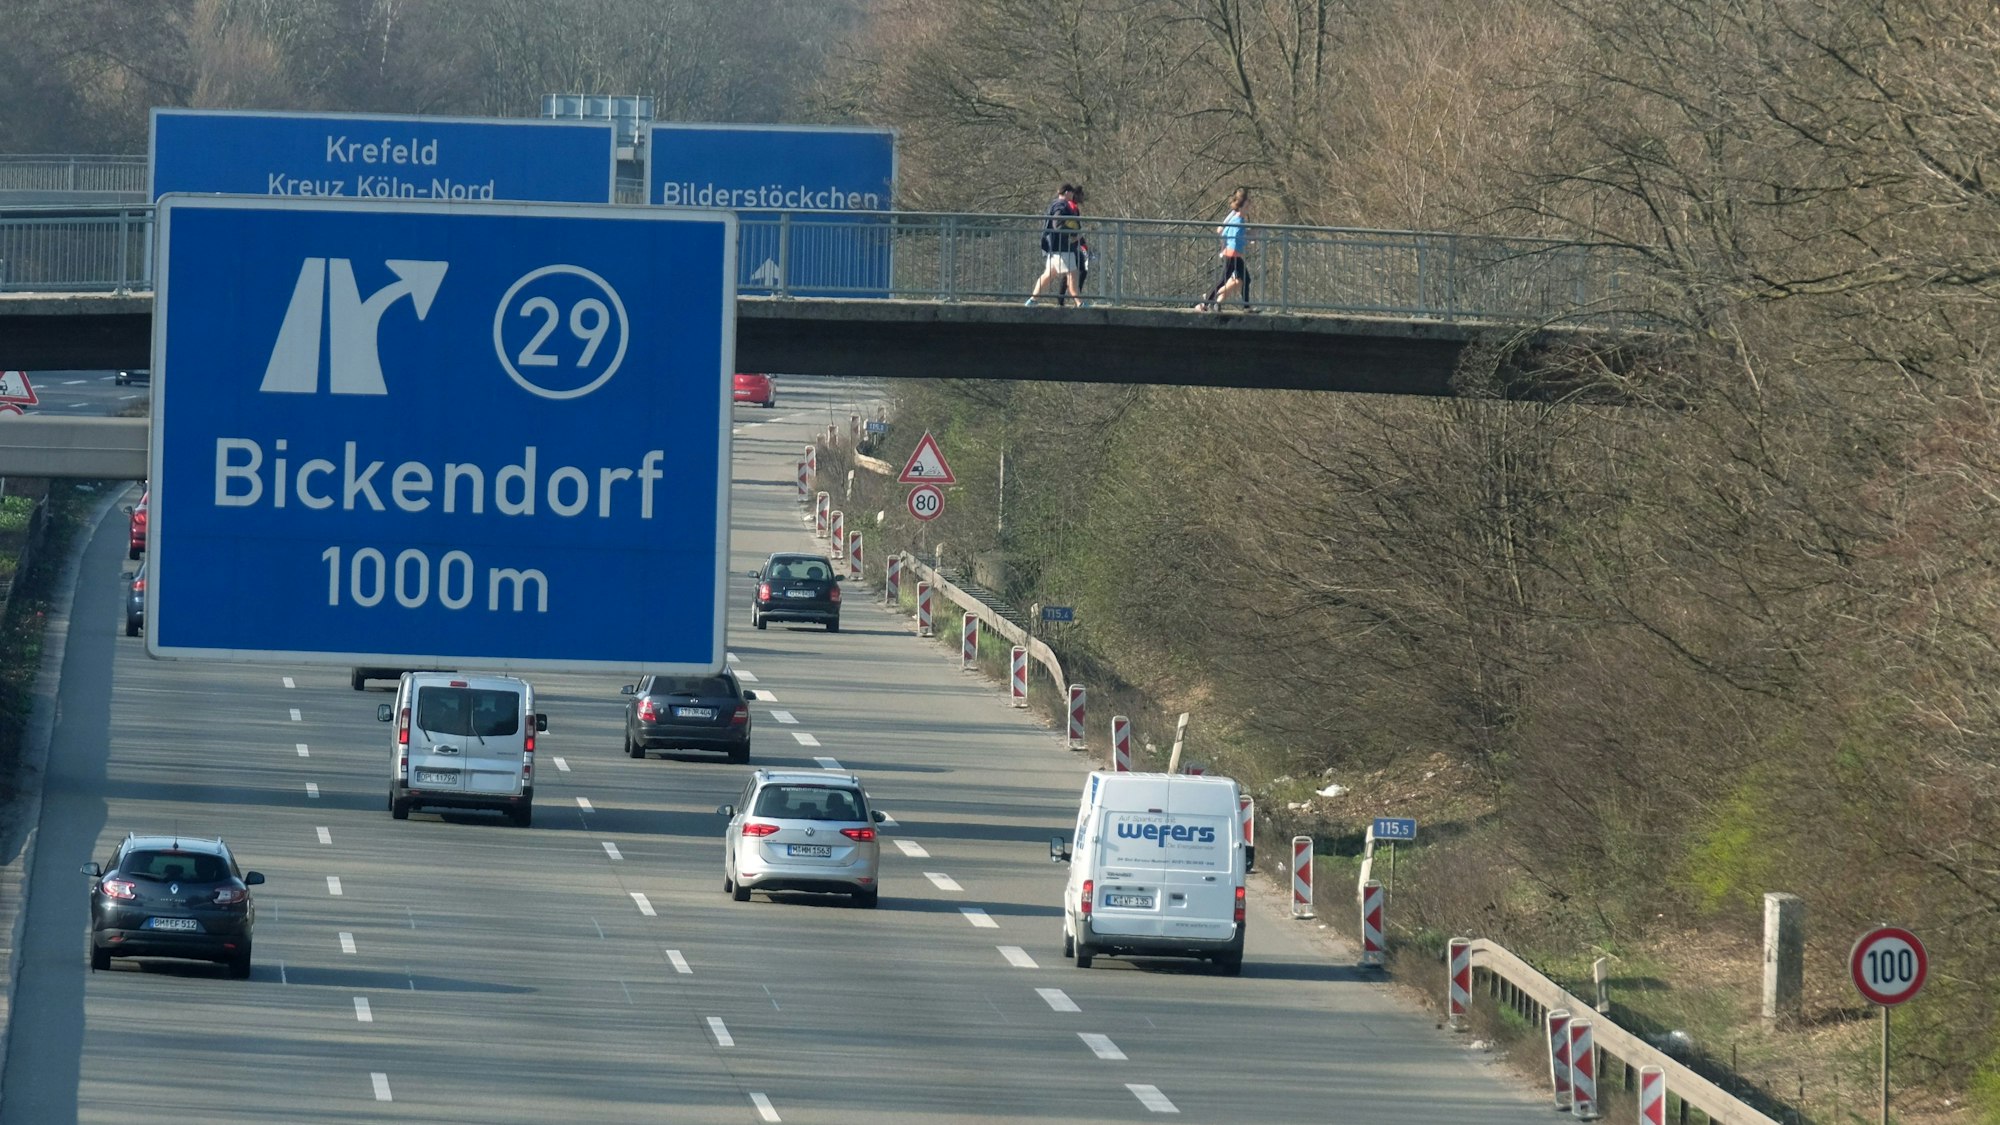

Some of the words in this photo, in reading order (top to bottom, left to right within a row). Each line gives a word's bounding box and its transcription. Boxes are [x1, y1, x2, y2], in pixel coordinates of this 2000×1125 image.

[326, 135, 438, 165] Krefeld
[268, 173, 345, 197] Kreuz
[357, 175, 495, 200] Köln-Nord
[663, 182, 879, 210] Bilderstöckchen
[518, 296, 610, 368] 29
[214, 437, 665, 519] Bickendorf
[916, 494, 937, 511] 80
[321, 546, 474, 610] 1000
[488, 567, 549, 612] m
[1117, 823, 1215, 848] wefers
[1380, 821, 1409, 835] 115.5
[1868, 948, 1913, 984] 100
